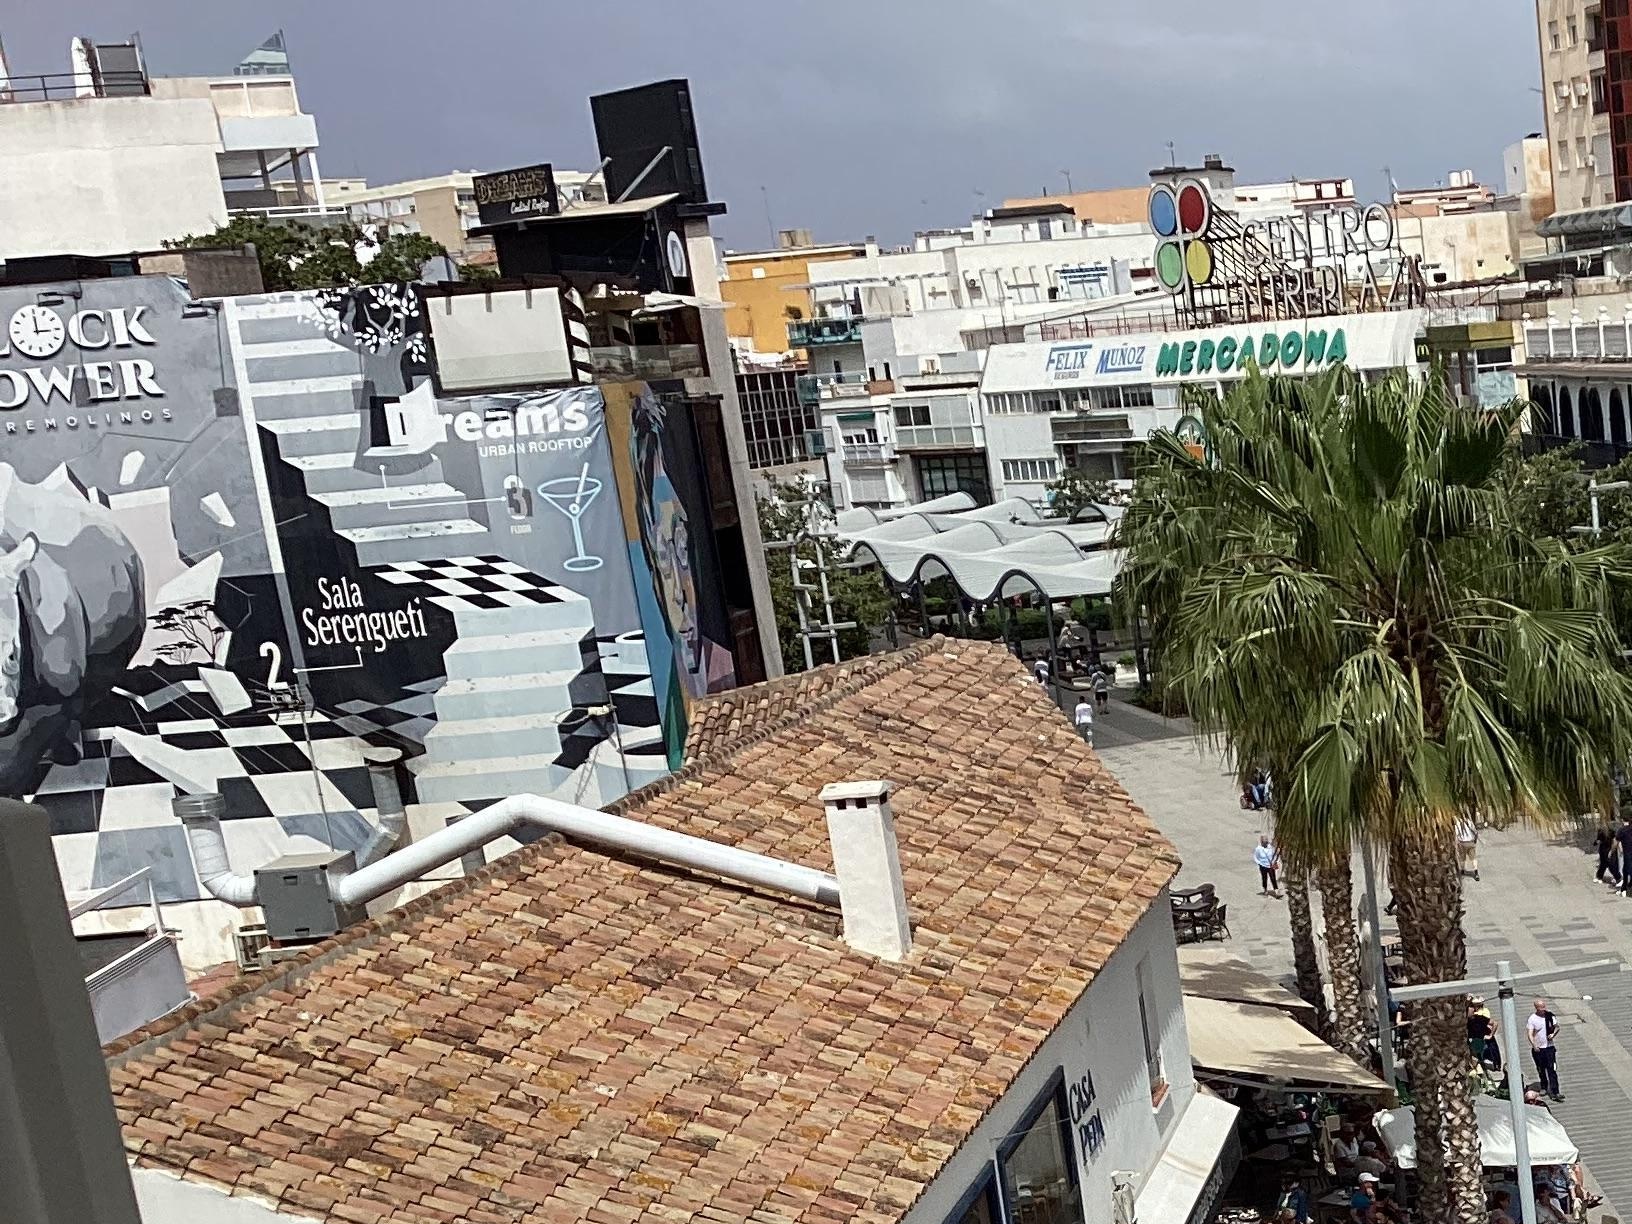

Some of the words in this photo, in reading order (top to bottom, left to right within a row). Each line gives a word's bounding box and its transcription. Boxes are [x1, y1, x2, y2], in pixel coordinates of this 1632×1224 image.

[1240, 201, 1394, 268] CENTRO
[1046, 343, 1093, 372] FELIX
[1095, 342, 1146, 374] MUÑOZ
[1156, 328, 1348, 378] MERCADONA
[480, 442, 526, 458] URBAN
[529, 437, 594, 454] ROOFTOP
[317, 576, 365, 610] Sala
[302, 597, 428, 653] Serengueti
[259, 641, 289, 690] 2
[1069, 1068, 1097, 1125] CASA
